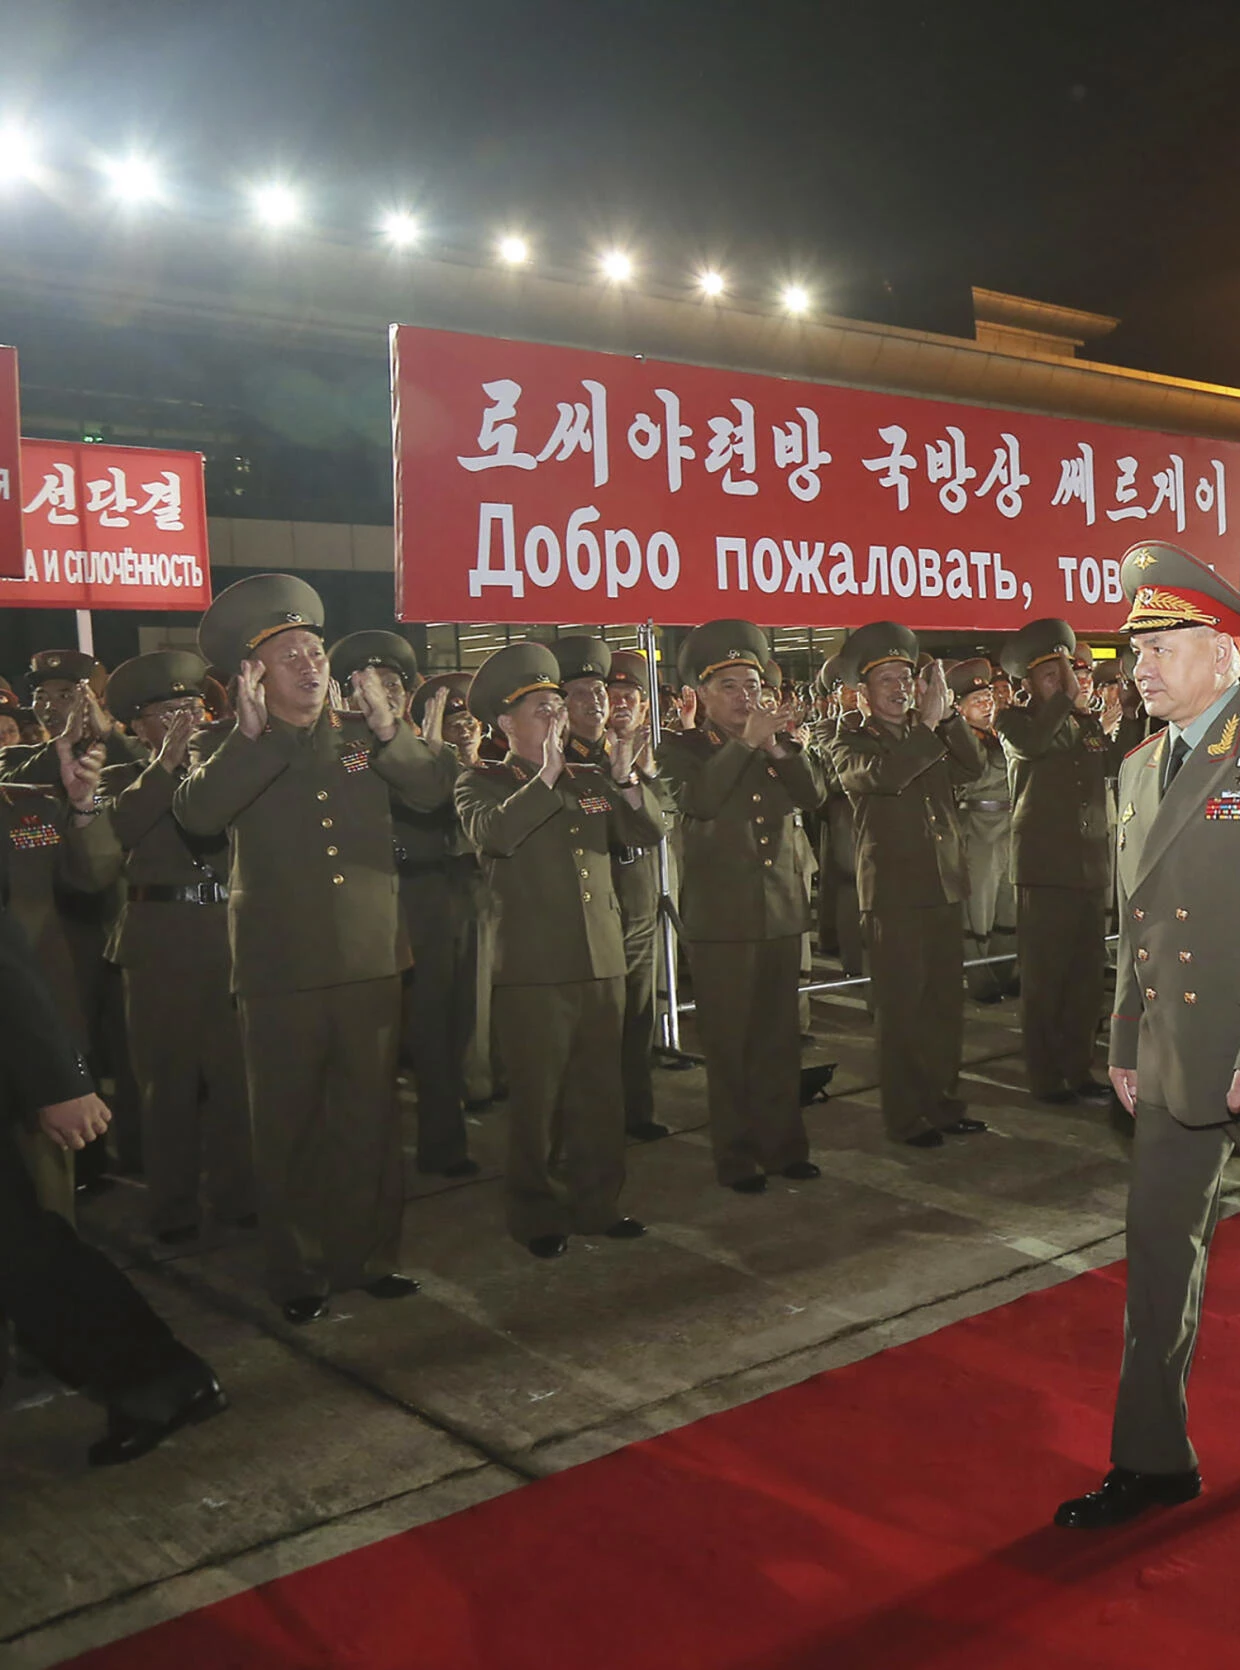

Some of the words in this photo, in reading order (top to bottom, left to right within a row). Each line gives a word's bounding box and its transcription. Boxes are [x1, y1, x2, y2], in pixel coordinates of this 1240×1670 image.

[457, 379, 832, 502] 로씨야련방
[861, 424, 1030, 518] 국방상
[1051, 442, 1227, 536] 쎄르게이
[43, 549, 59, 582] И
[64, 547, 203, 587] СПЛОЧЁННОСТЬ
[468, 502, 681, 598] Добро
[715, 536, 1033, 610] пожаловать,
